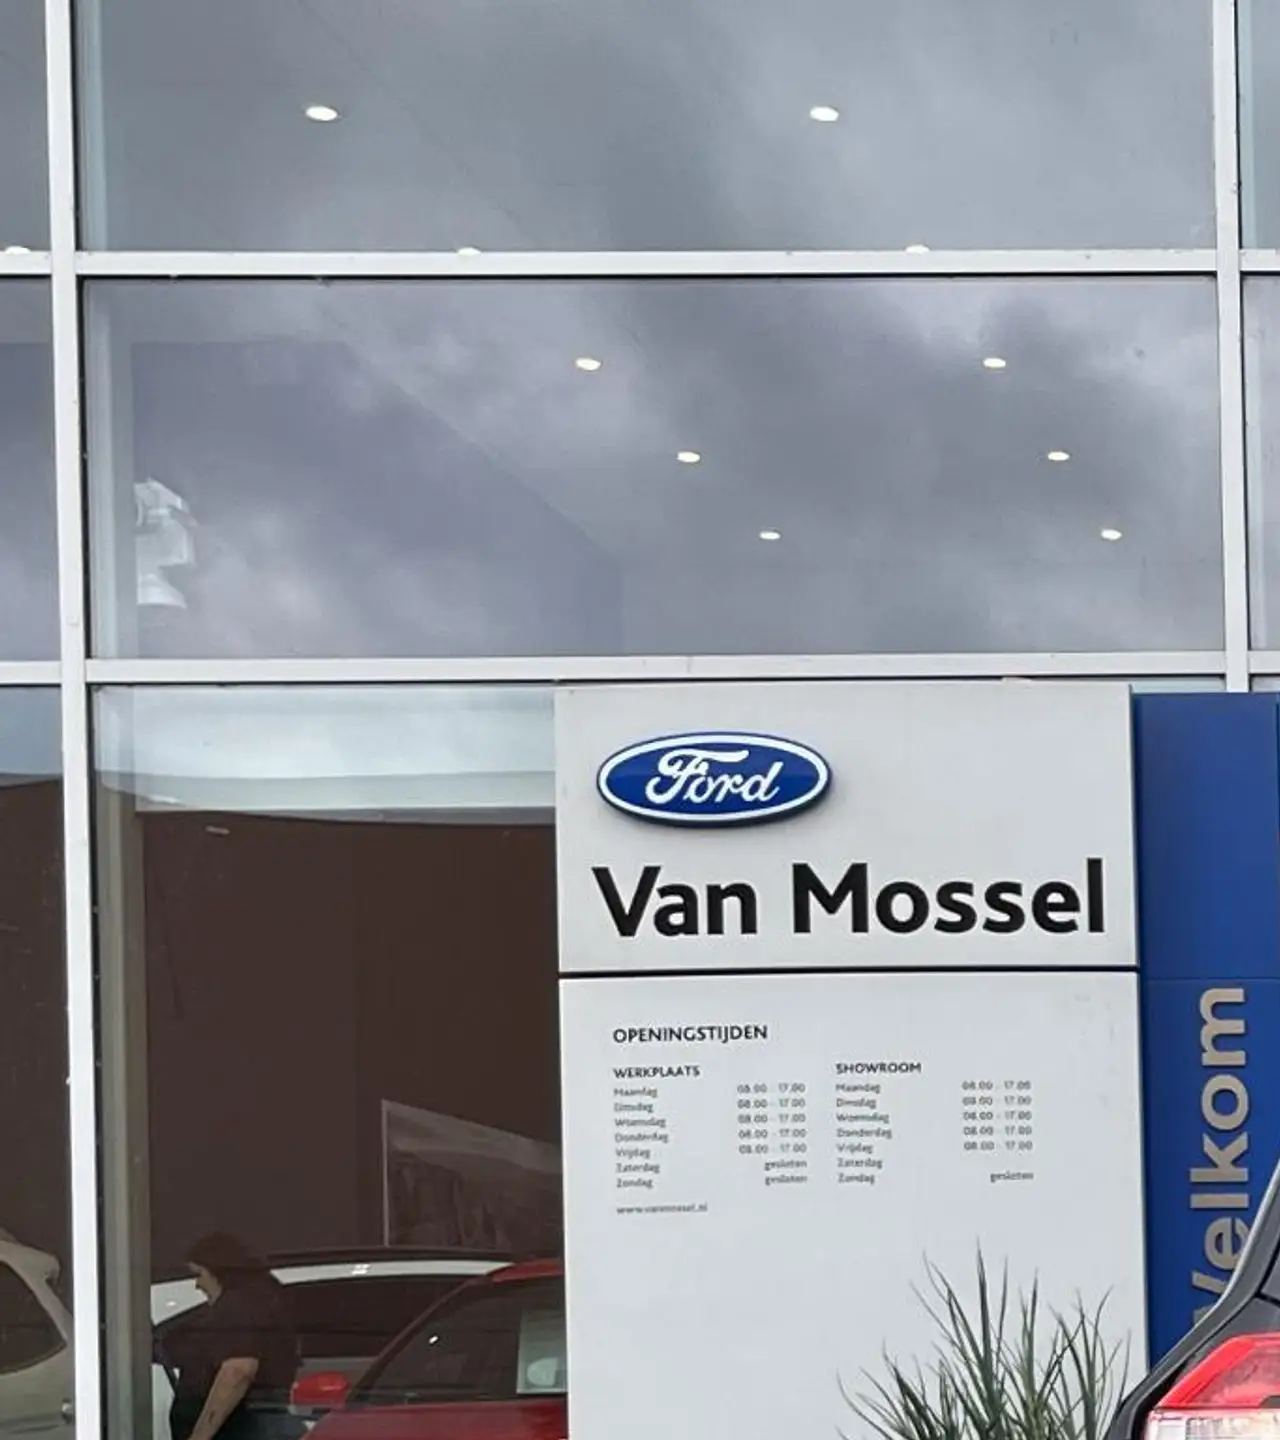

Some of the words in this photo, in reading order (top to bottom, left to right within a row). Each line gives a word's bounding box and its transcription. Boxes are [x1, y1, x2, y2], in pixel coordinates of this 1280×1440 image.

[644, 748, 785, 804] Ford
[592, 865, 758, 937] Van
[792, 857, 1105, 934] Mossel
[613, 1025, 768, 1044] OPENINGSTIJDEN
[613, 1065, 700, 1079] WERKPLAATS
[836, 1062, 922, 1074] SHOWROOM
[615, 1131, 669, 1144] Donderdag
[616, 1178, 653, 1189] Zondag
